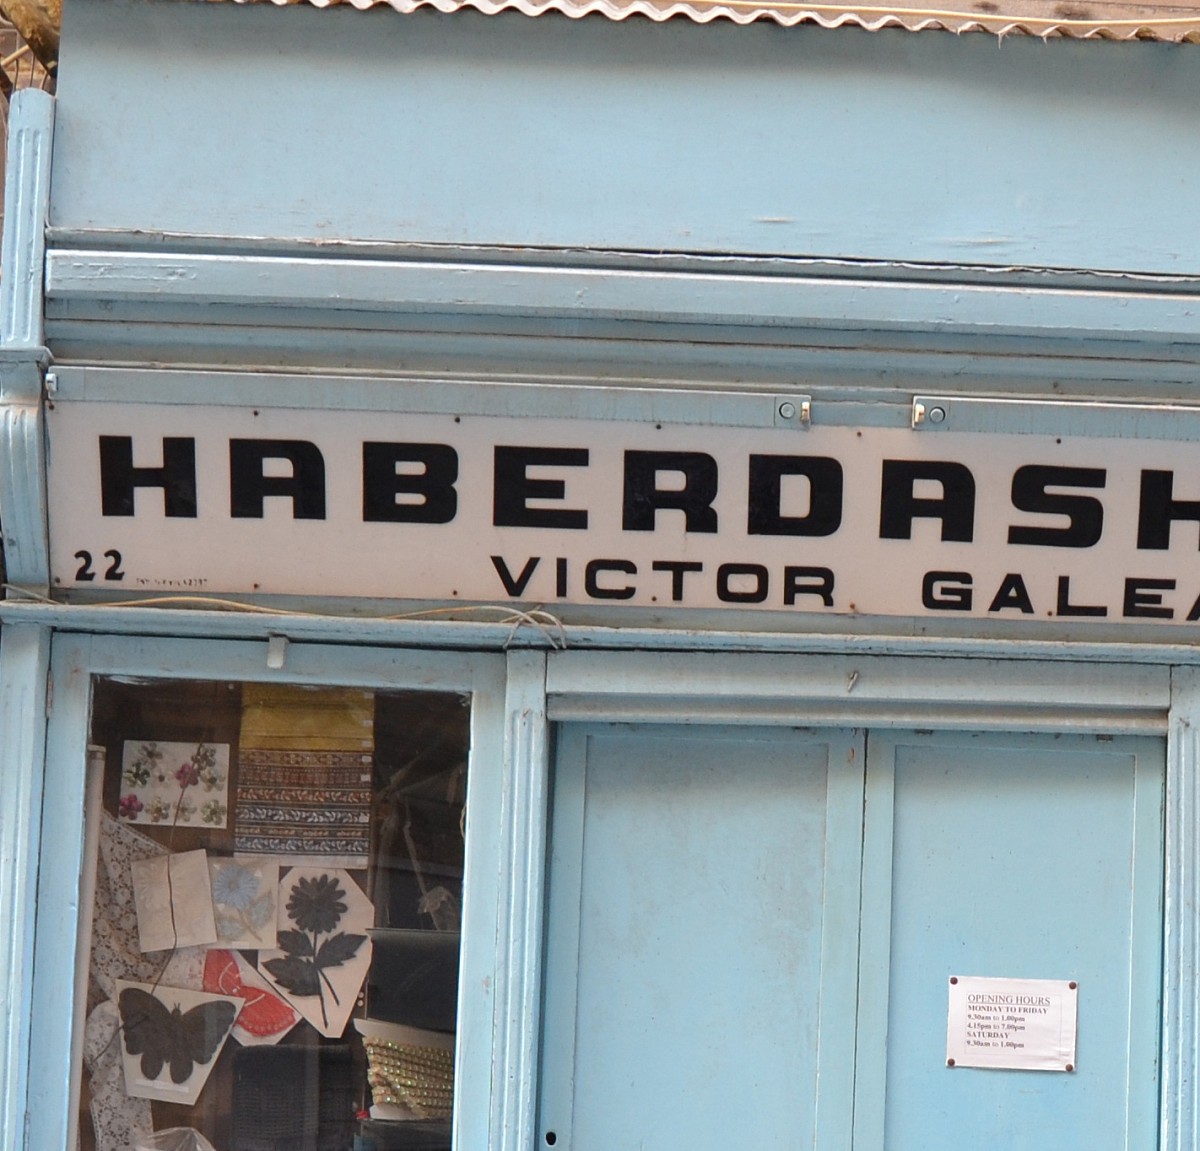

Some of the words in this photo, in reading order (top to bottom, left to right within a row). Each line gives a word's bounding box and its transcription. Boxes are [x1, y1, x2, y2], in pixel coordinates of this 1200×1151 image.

[74, 549, 125, 581] 22
[490, 555, 836, 608] VICTOR
[968, 994, 1013, 1003] OPENING
[1016, 996, 1051, 1005] HOURS
[966, 1031, 1010, 1039] SATURDAY
